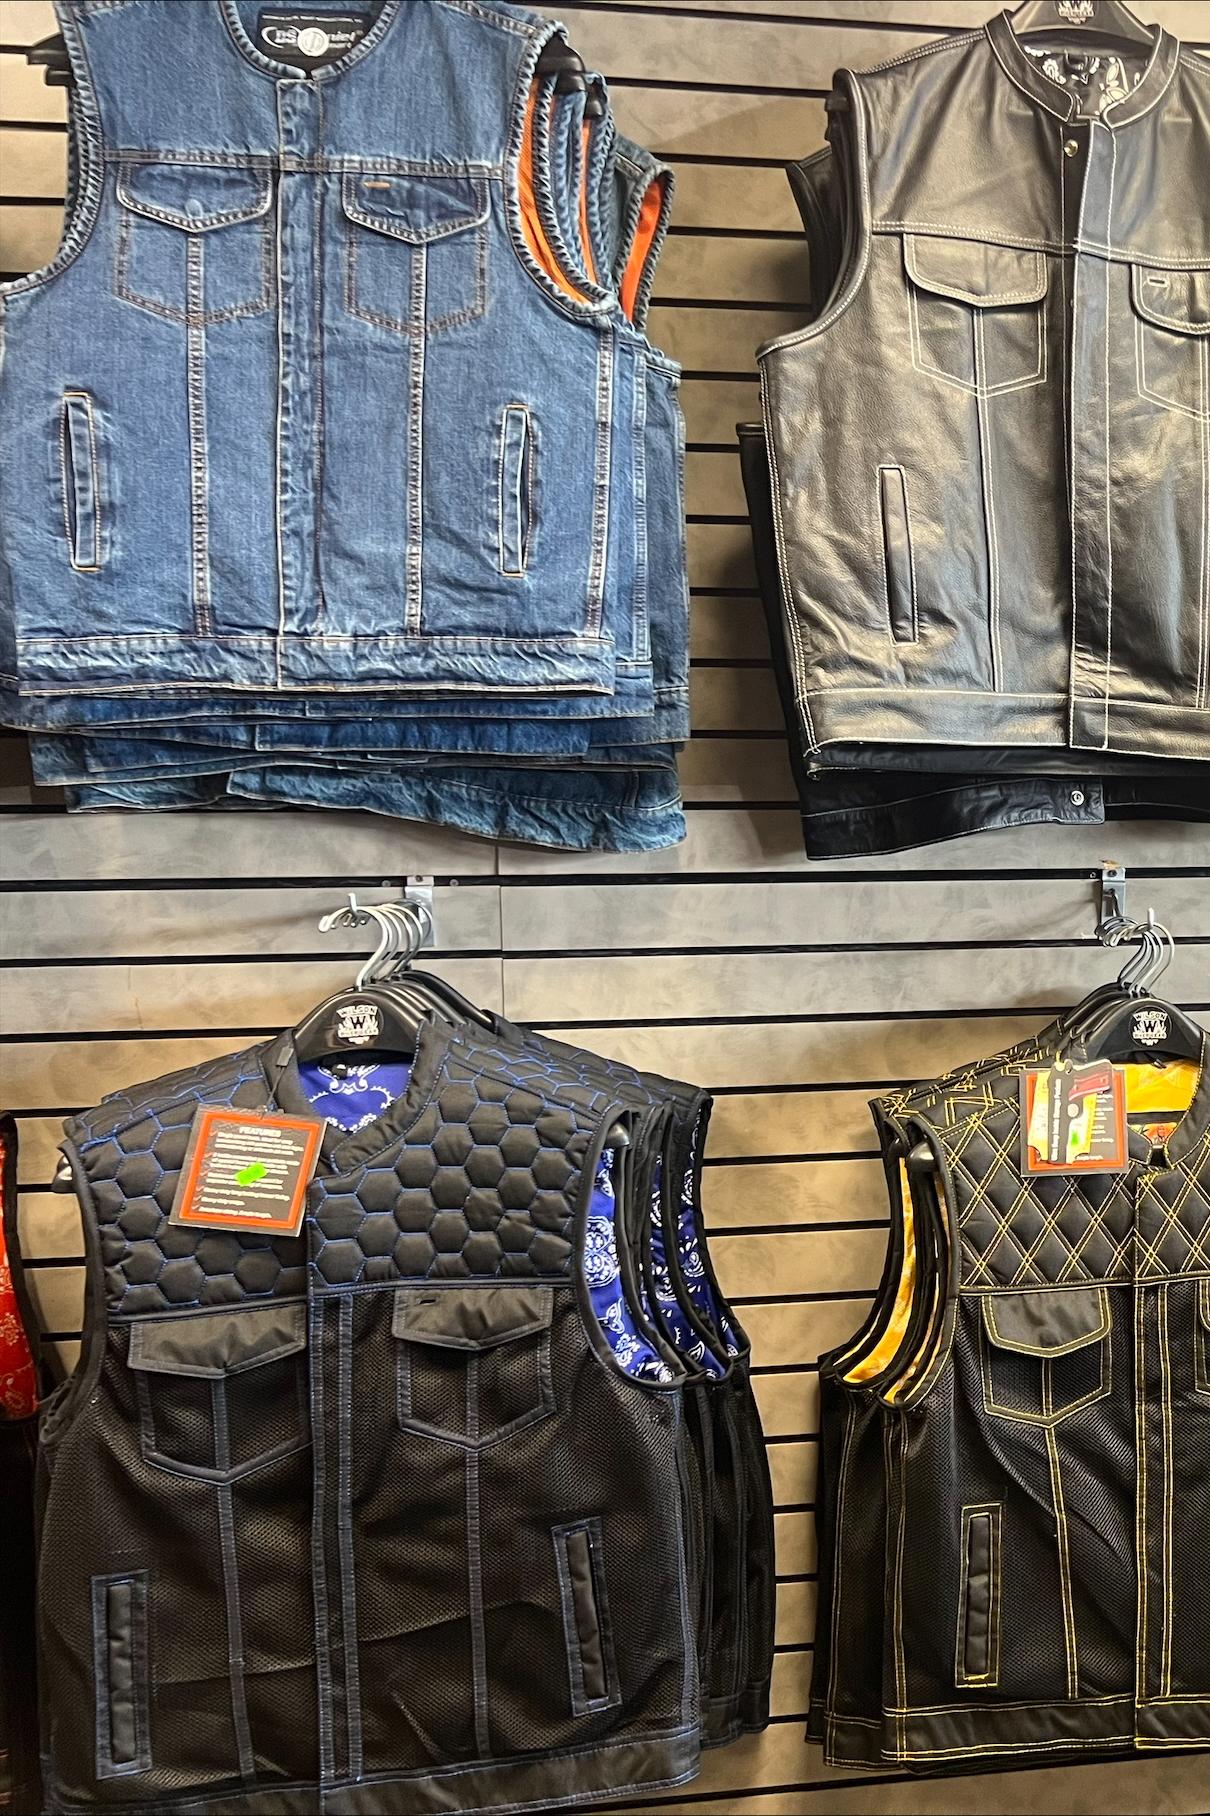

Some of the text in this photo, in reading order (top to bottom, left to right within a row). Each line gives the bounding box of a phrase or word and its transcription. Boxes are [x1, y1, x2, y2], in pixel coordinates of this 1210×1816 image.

[338, 1005, 377, 1017] WILSON
[1134, 1011, 1167, 1021] WILSON
[351, 1016, 366, 1029] W
[1144, 1020, 1157, 1032] W
